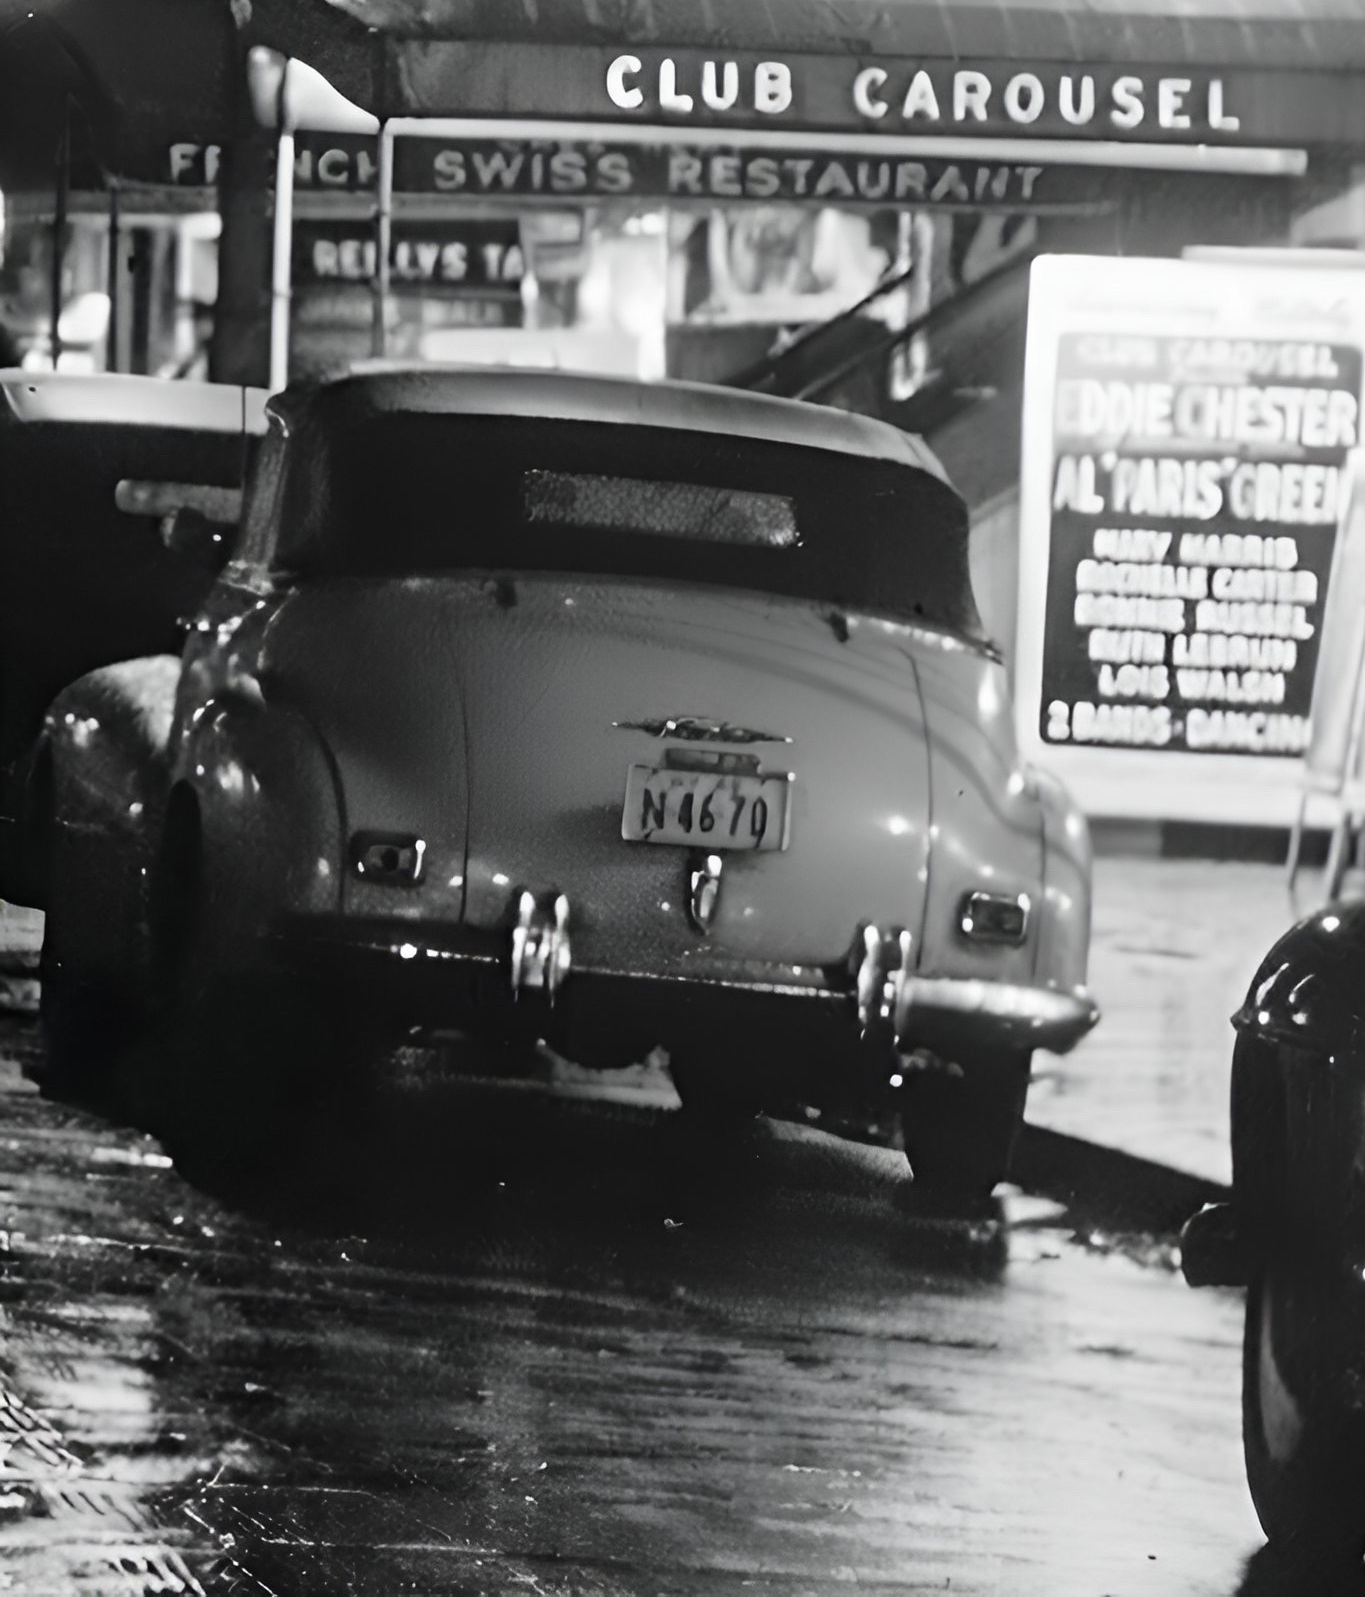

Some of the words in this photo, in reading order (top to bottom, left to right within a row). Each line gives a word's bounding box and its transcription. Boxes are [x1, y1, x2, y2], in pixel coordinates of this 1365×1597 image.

[605, 53, 794, 114] CLUB
[852, 66, 1241, 132] CAROUSEL
[432, 150, 633, 192] SWISS
[667, 152, 1044, 202] RESTAURANT
[1057, 379, 1174, 440] EDDIE
[1175, 387, 1358, 448] CHESTER
[1053, 455, 1105, 515] AL
